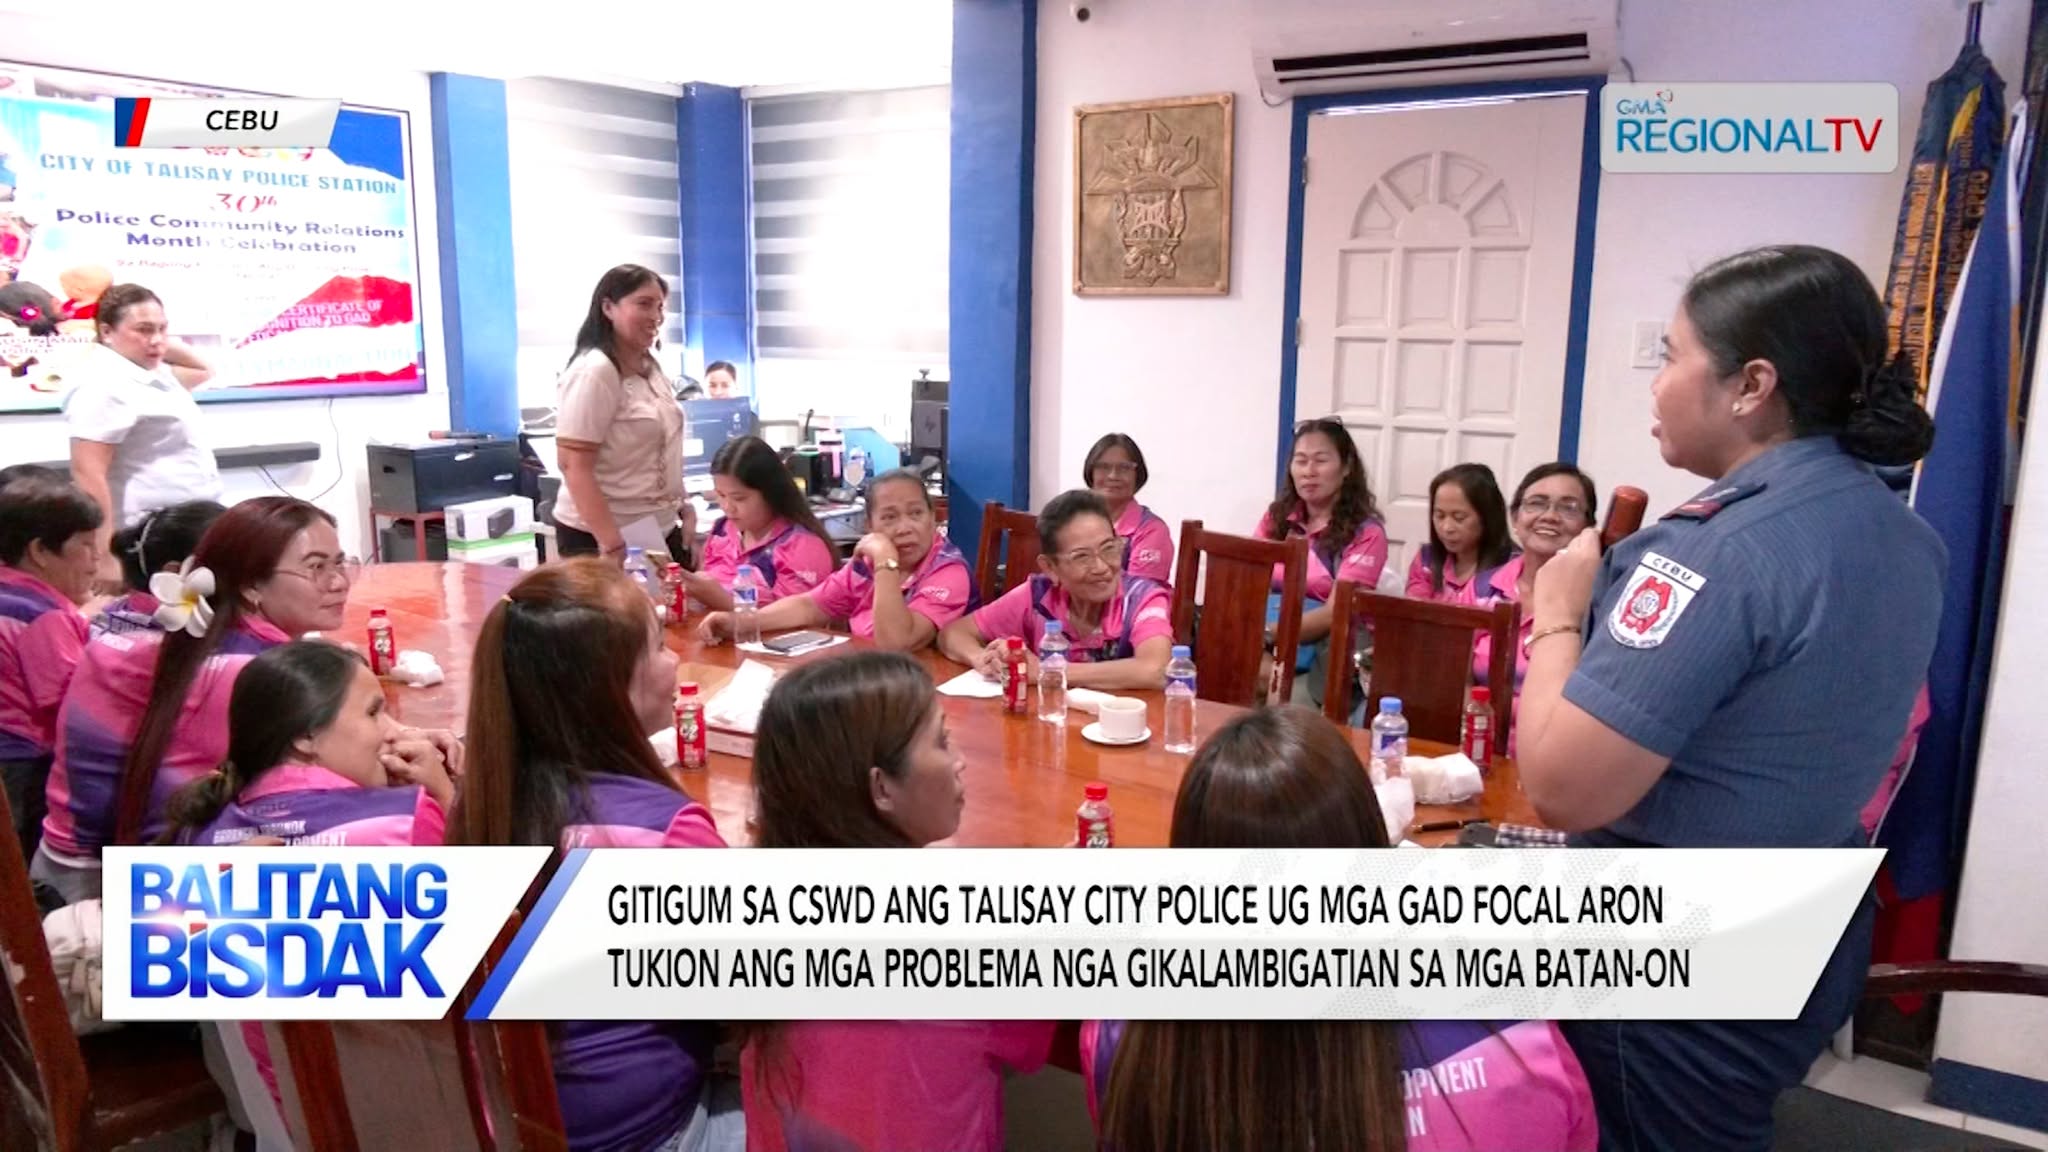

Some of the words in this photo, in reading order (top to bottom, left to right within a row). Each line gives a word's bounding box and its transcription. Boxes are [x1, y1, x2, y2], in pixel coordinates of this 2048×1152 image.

[40, 153, 94, 172] CITY
[107, 159, 132, 175] OF
[145, 162, 232, 182] TALISAY
[243, 169, 310, 188] POLICE
[318, 176, 397, 194] STATION
[56, 208, 141, 227] Police
[305, 222, 405, 239] Relations
[126, 232, 211, 248] Month
